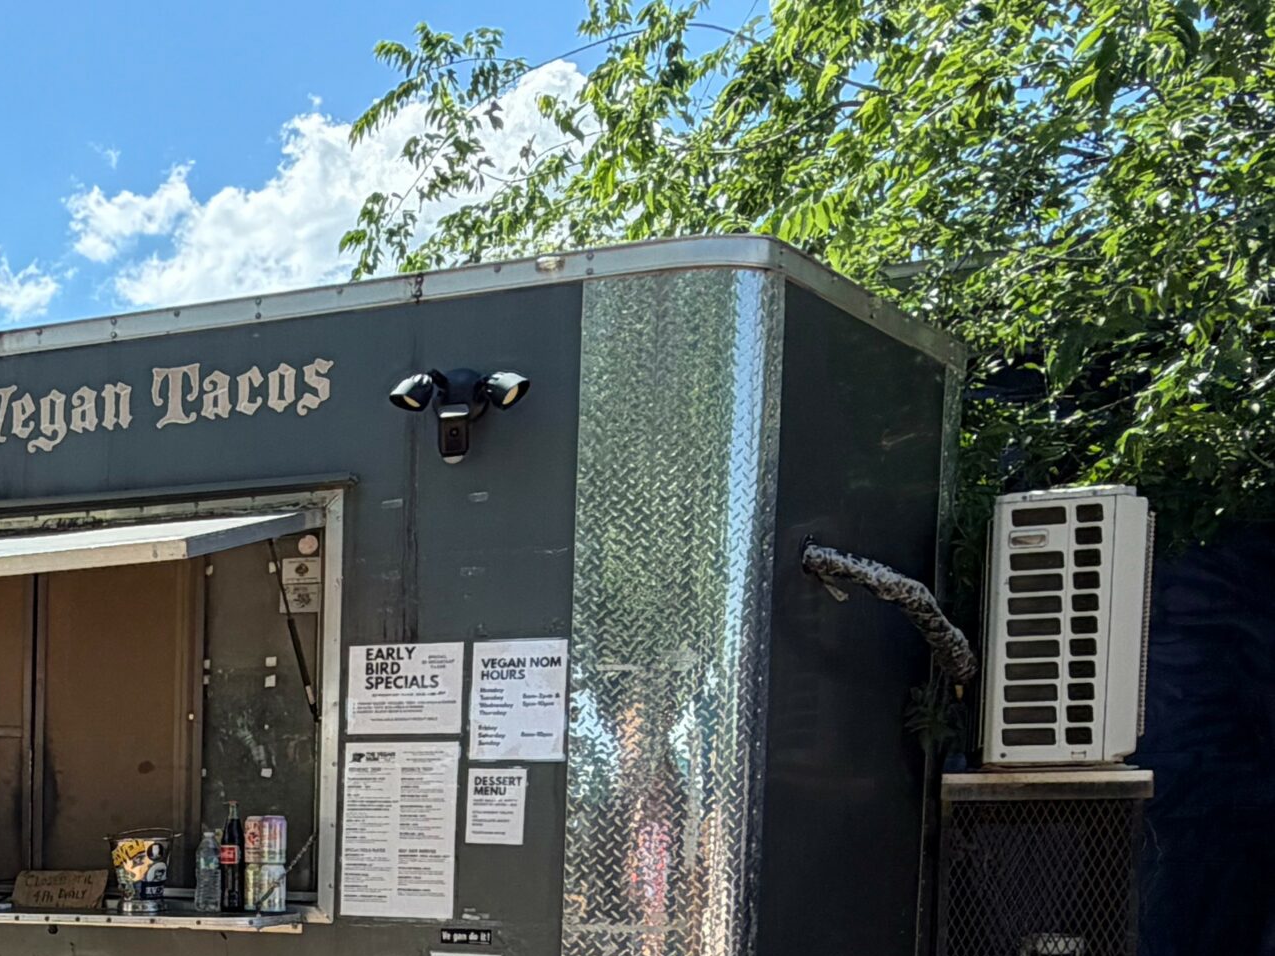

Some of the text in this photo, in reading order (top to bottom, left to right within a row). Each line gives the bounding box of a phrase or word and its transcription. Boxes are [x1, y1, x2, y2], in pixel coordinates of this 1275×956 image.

[150, 358, 334, 430] Tacos
[365, 646, 417, 660] EARLY
[365, 661, 401, 676] BIRD
[480, 656, 562, 669] VEGAN NOM
[481, 669, 526, 681] HOURS
[365, 674, 440, 690] SPECIALS
[479, 694, 504, 702] Tuesday
[479, 709, 507, 717] Thursday
[478, 739, 501, 747] Sunday
[474, 776, 523, 787] DESSERT
[473, 786, 507, 796] MENU
